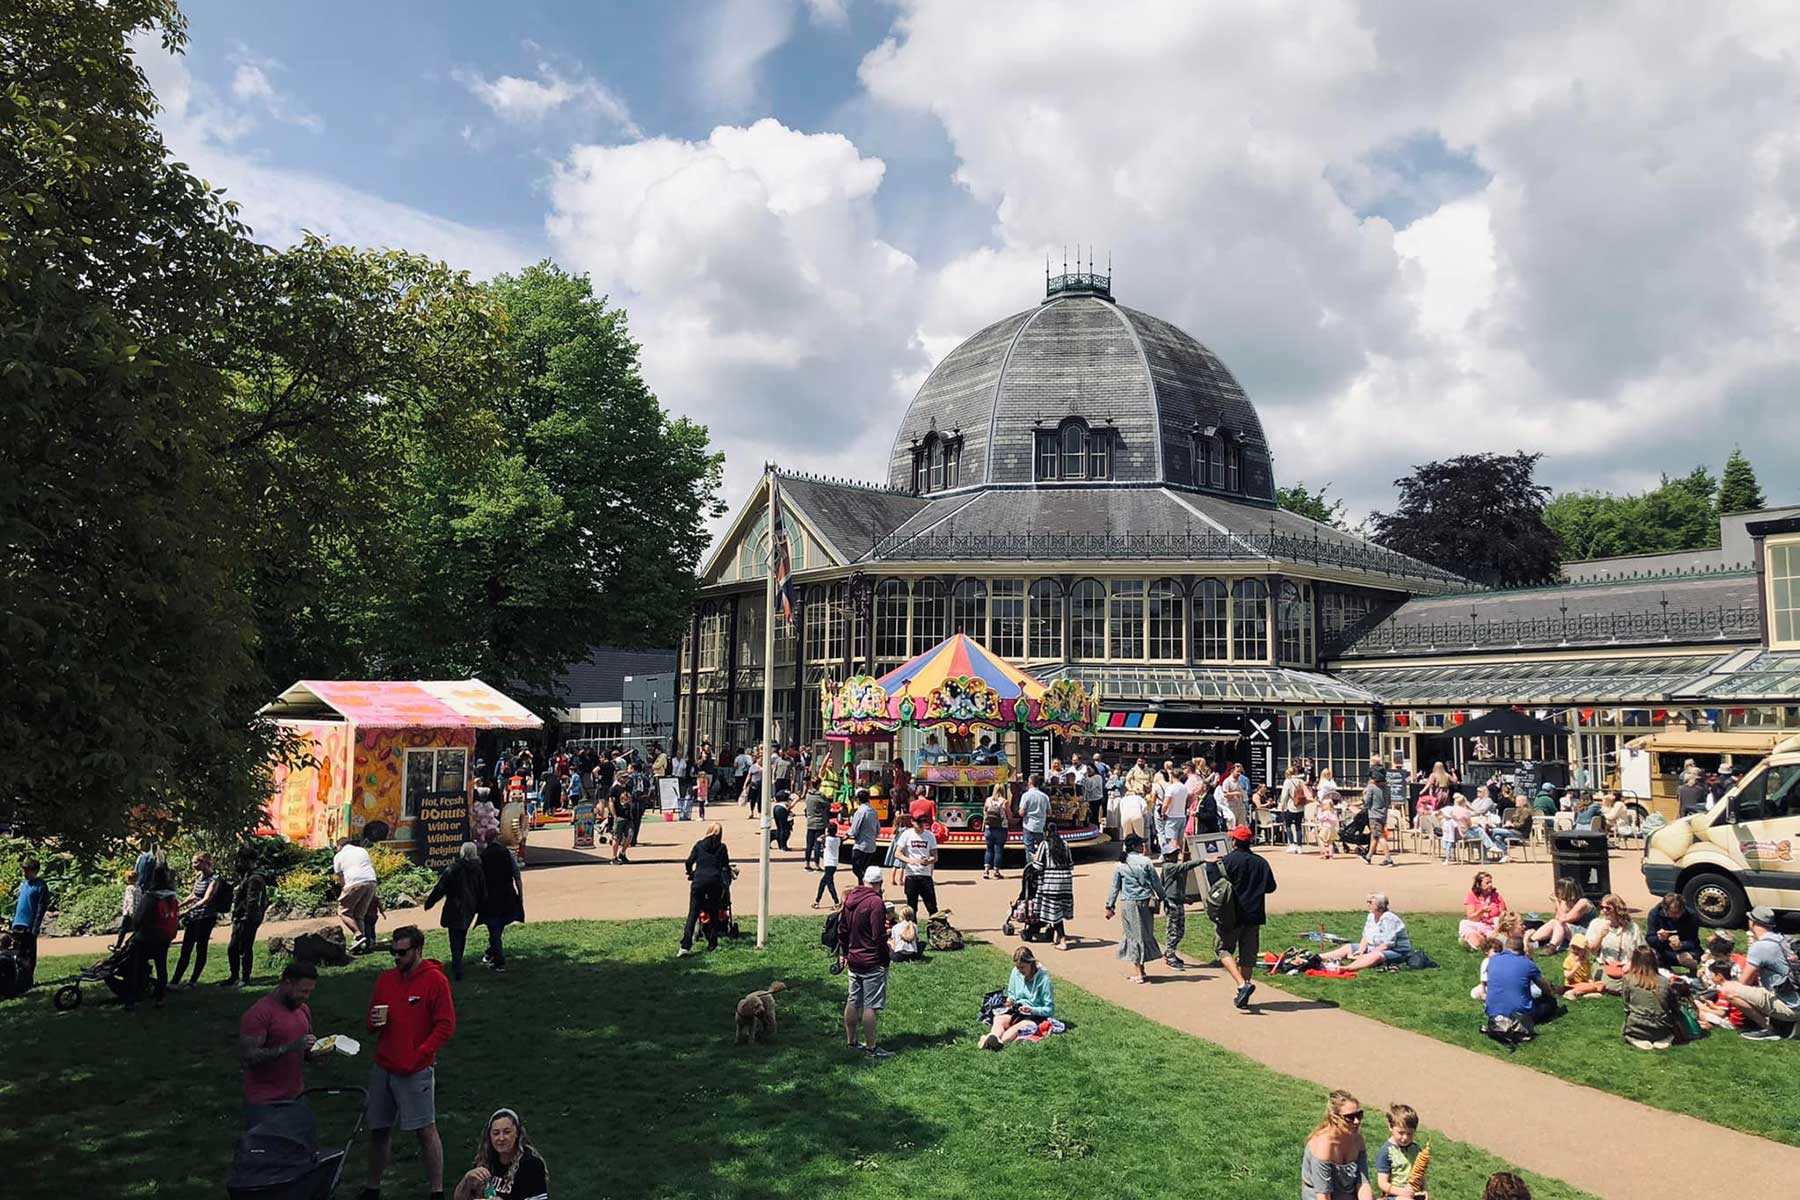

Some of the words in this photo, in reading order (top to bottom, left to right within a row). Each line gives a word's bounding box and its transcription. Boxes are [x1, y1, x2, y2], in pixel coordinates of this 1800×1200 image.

[421, 798, 439, 807] Hot,
[440, 796, 464, 806] Fresh
[427, 821, 449, 831] With
[450, 822, 461, 830] or
[427, 833, 463, 843] Without
[425, 856, 456, 868] Chocol
